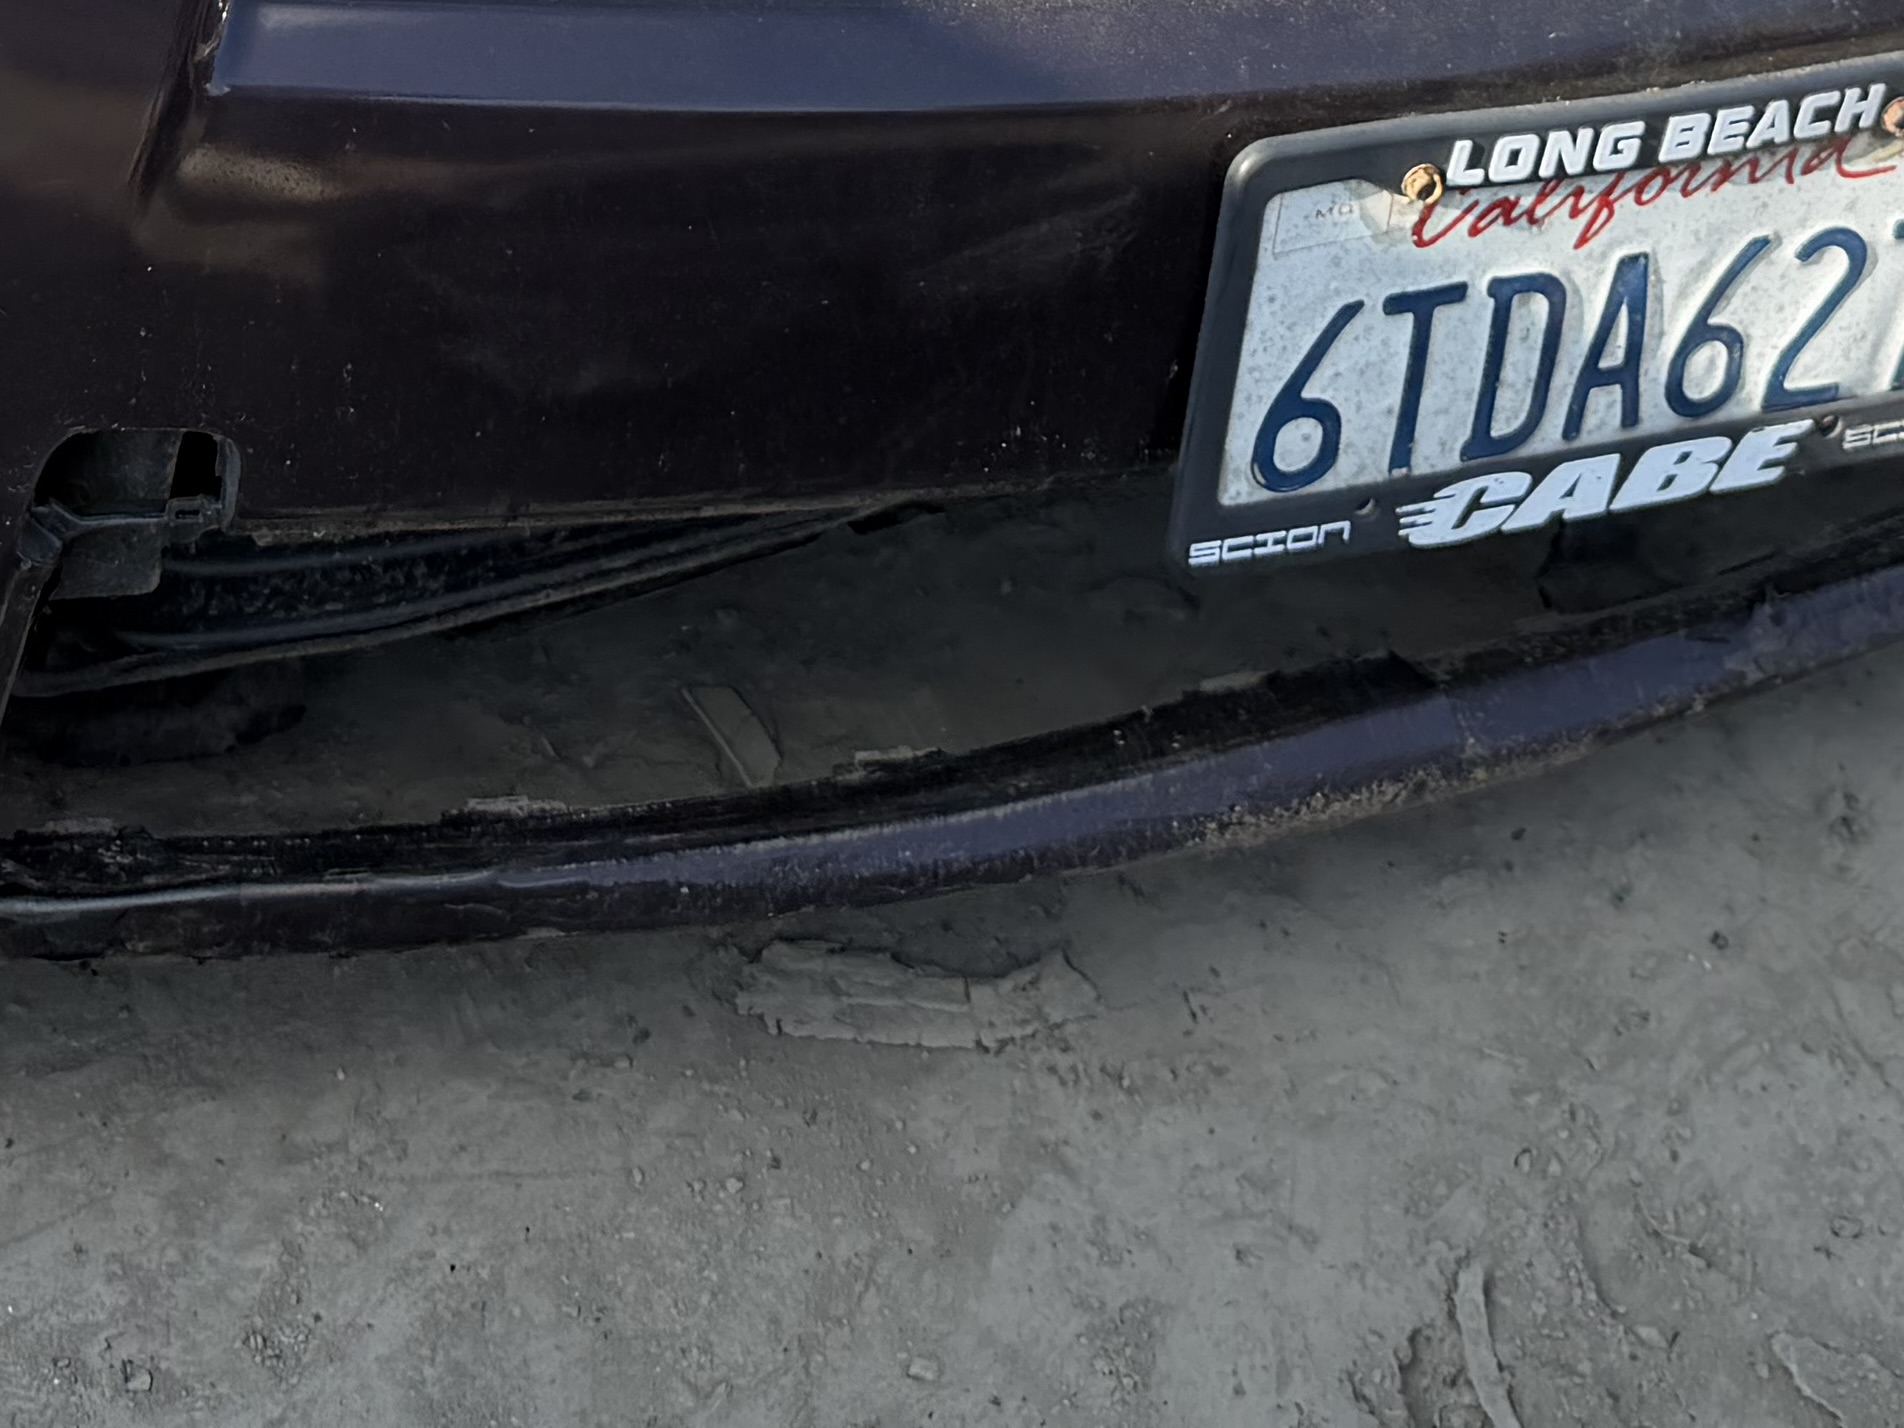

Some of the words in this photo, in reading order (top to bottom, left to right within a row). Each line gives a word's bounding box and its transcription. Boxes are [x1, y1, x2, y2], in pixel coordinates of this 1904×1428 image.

[1445, 120, 1646, 187] LONG
[1657, 82, 1887, 163] BEACH
[1398, 418, 1812, 548] CABE
[1188, 518, 1352, 569] SCION
